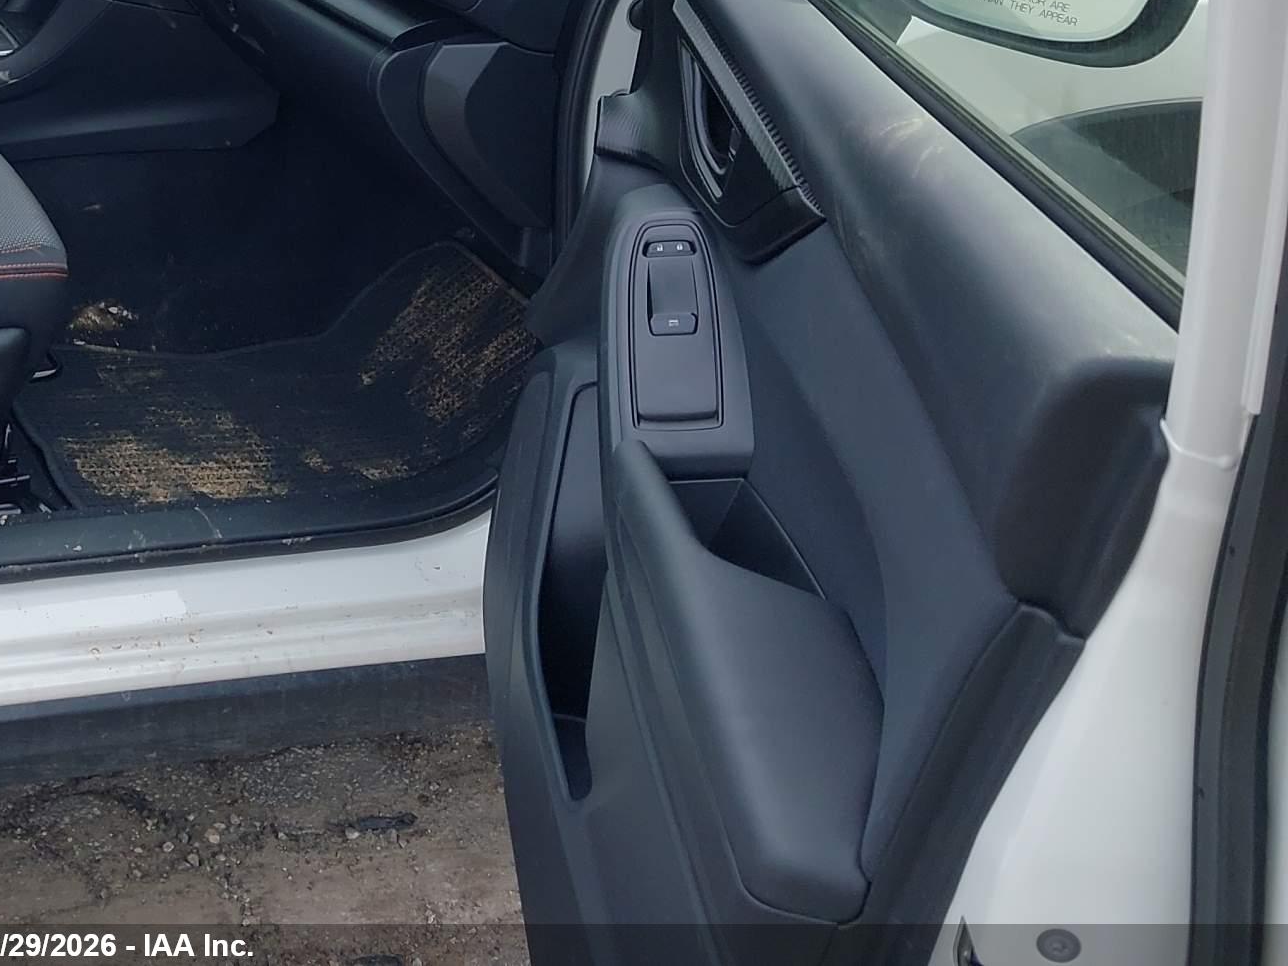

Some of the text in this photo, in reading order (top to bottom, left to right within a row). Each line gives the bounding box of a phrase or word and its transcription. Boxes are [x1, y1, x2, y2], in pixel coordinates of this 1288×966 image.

[1011, 0, 1033, 14] THEY
[1039, 9, 1078, 26] APPEAR
[1049, 0, 1071, 13] ARE
